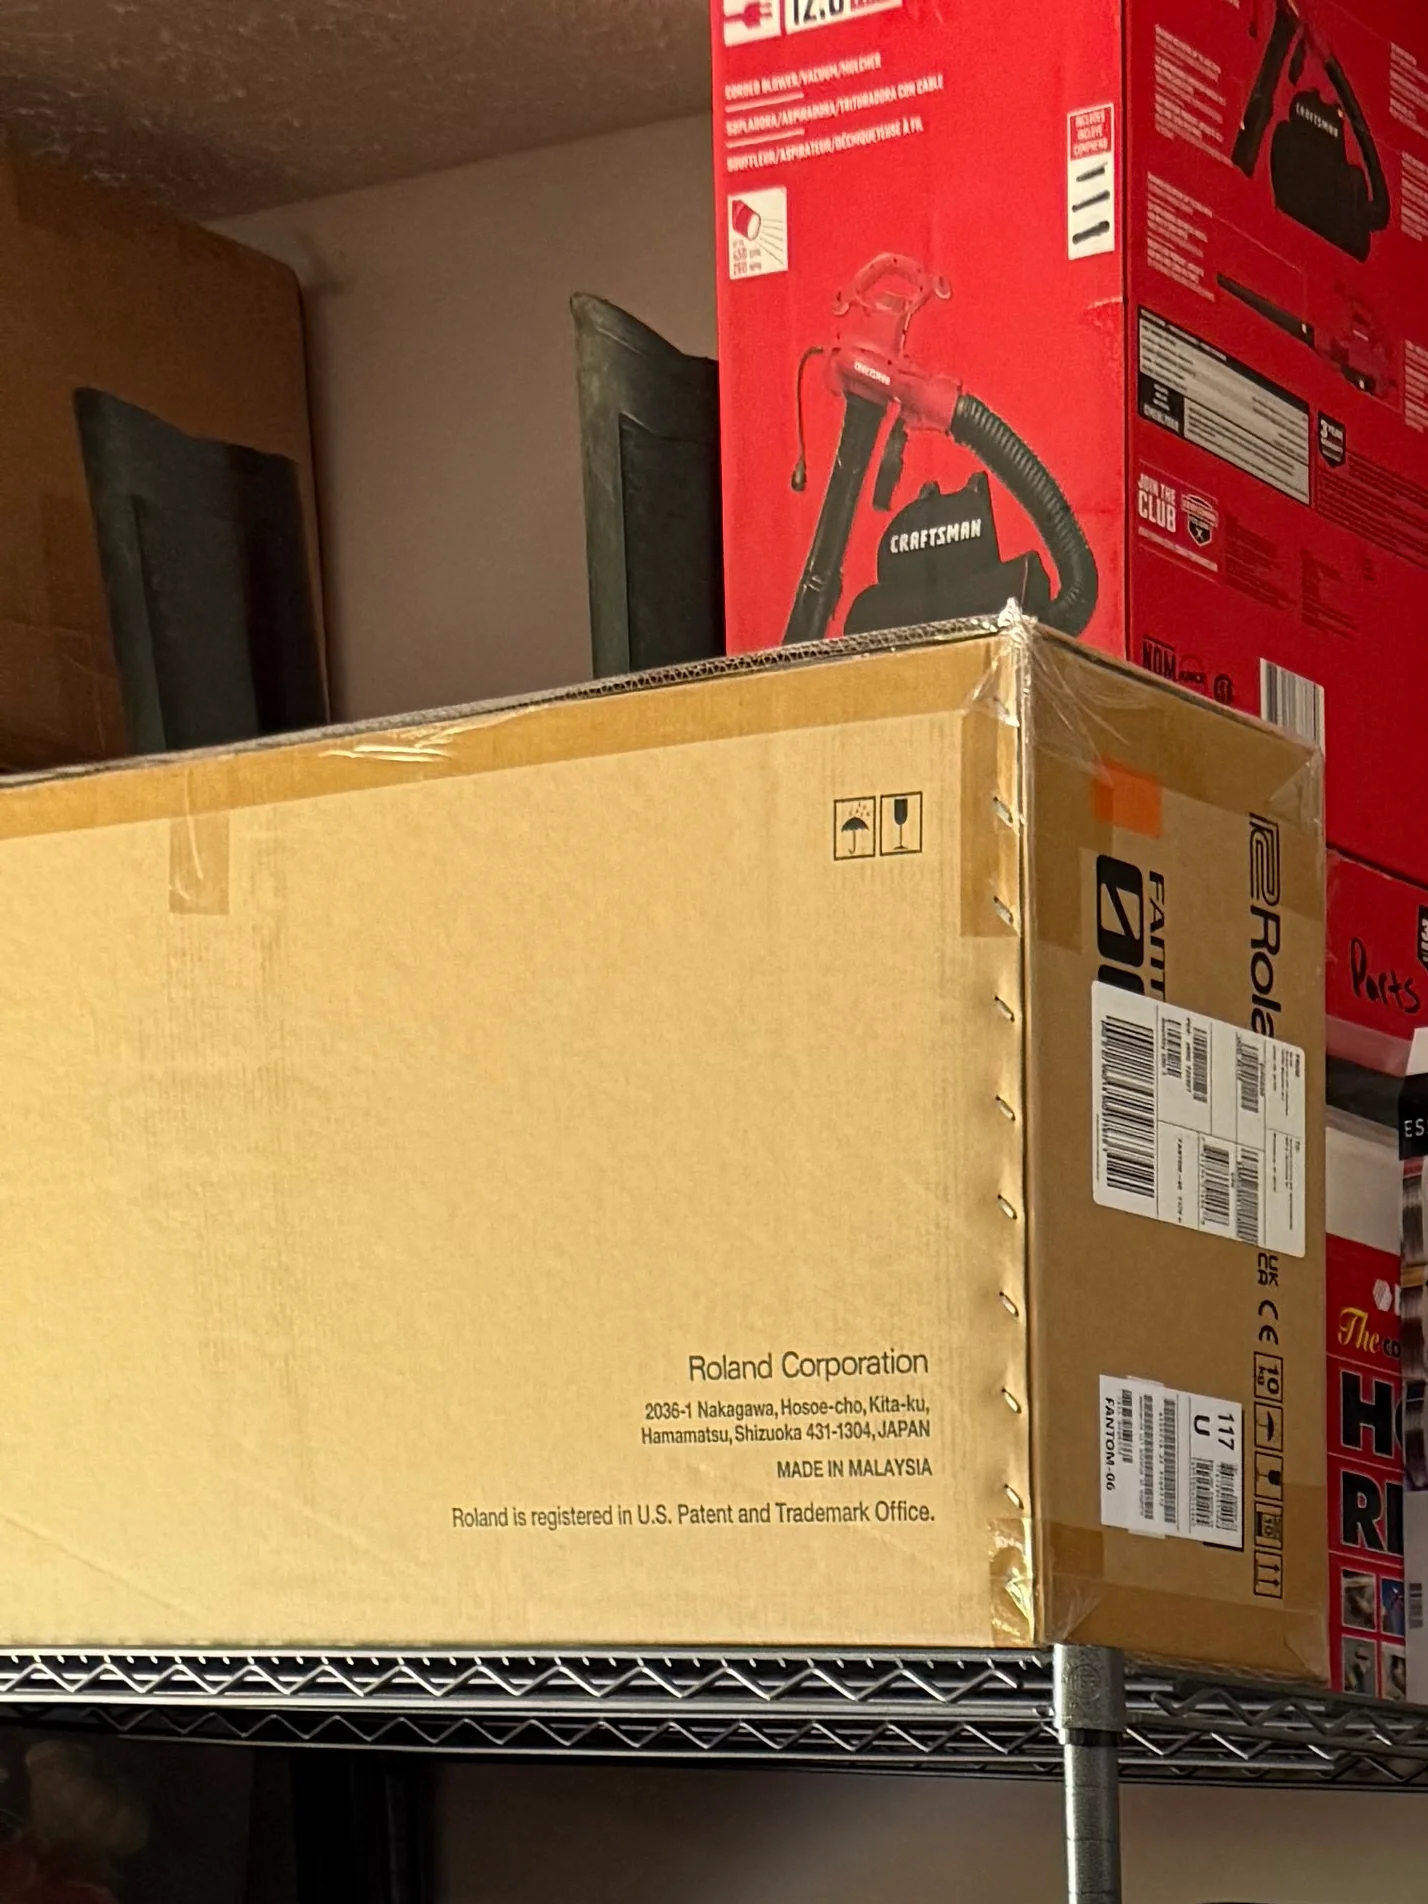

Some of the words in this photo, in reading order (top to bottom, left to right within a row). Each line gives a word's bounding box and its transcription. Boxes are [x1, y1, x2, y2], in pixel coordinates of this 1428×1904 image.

[1159, 479, 1176, 501] THE
[1137, 489, 1176, 533] CLUB
[890, 518, 982, 554] CRAFTSMAN
[1149, 870, 1166, 1001] FANT
[1250, 905, 1282, 1037] Rola
[1350, 937, 1421, 1015] Parts
[1268, 1254, 1279, 1288] UK
[1338, 1307, 1380, 1350] The
[688, 1352, 771, 1381] Roland
[782, 1347, 928, 1381] Corporation
[1267, 1365, 1280, 1395] 10
[645, 1403, 691, 1420] 2036-1
[697, 1398, 778, 1420] Nakagawa,
[780, 1397, 866, 1417] Hosoe-cho,
[869, 1395, 930, 1415] Kita-ku,
[642, 1427, 732, 1445] Hamamatsu,
[735, 1424, 801, 1442] Shizuoka
[806, 1422, 875, 1441] 431-1304,
[877, 1420, 931, 1439] JAPAN
[1194, 1414, 1211, 1436] U
[1217, 1413, 1235, 1451] 117
[1105, 1397, 1116, 1492] FANTOM-06
[777, 1461, 823, 1479] MADE
[827, 1460, 843, 1477] IN
[848, 1458, 932, 1477] MALAYSIA
[453, 1507, 508, 1528] Roland
[512, 1507, 526, 1526] is
[531, 1505, 613, 1531] registered
[617, 1505, 632, 1525] in
[637, 1505, 672, 1524] U.S.
[677, 1503, 734, 1524] Patent
[737, 1502, 770, 1523] and
[775, 1501, 869, 1523] Trademark
[874, 1500, 934, 1522] Office.
